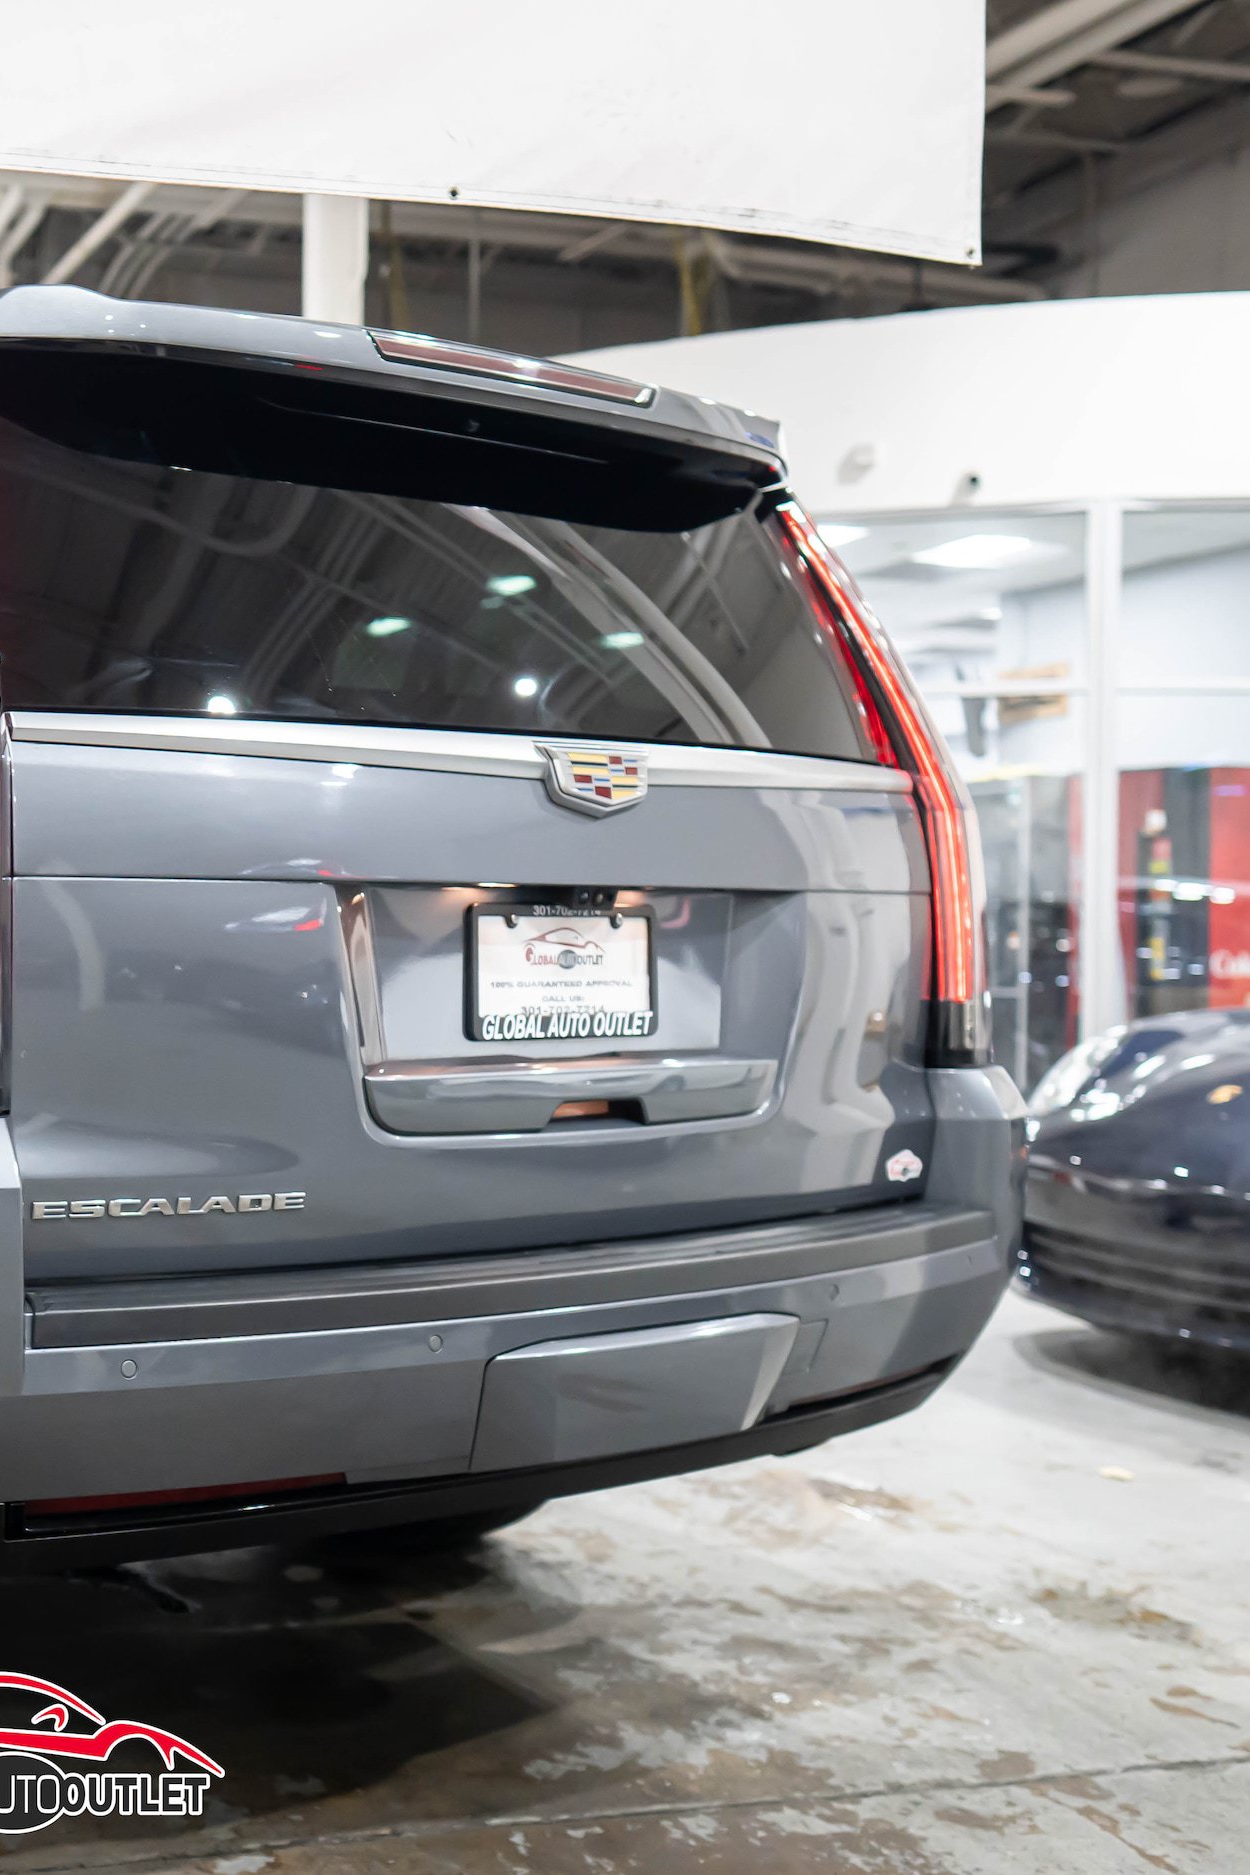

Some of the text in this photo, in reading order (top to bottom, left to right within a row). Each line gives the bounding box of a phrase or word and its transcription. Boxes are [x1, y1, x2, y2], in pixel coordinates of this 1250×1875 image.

[517, 980, 583, 988] GUARANTEED
[482, 1011, 653, 1040] GLOBAL AUTO OUTLET
[32, 1192, 306, 1219] ESCALADE
